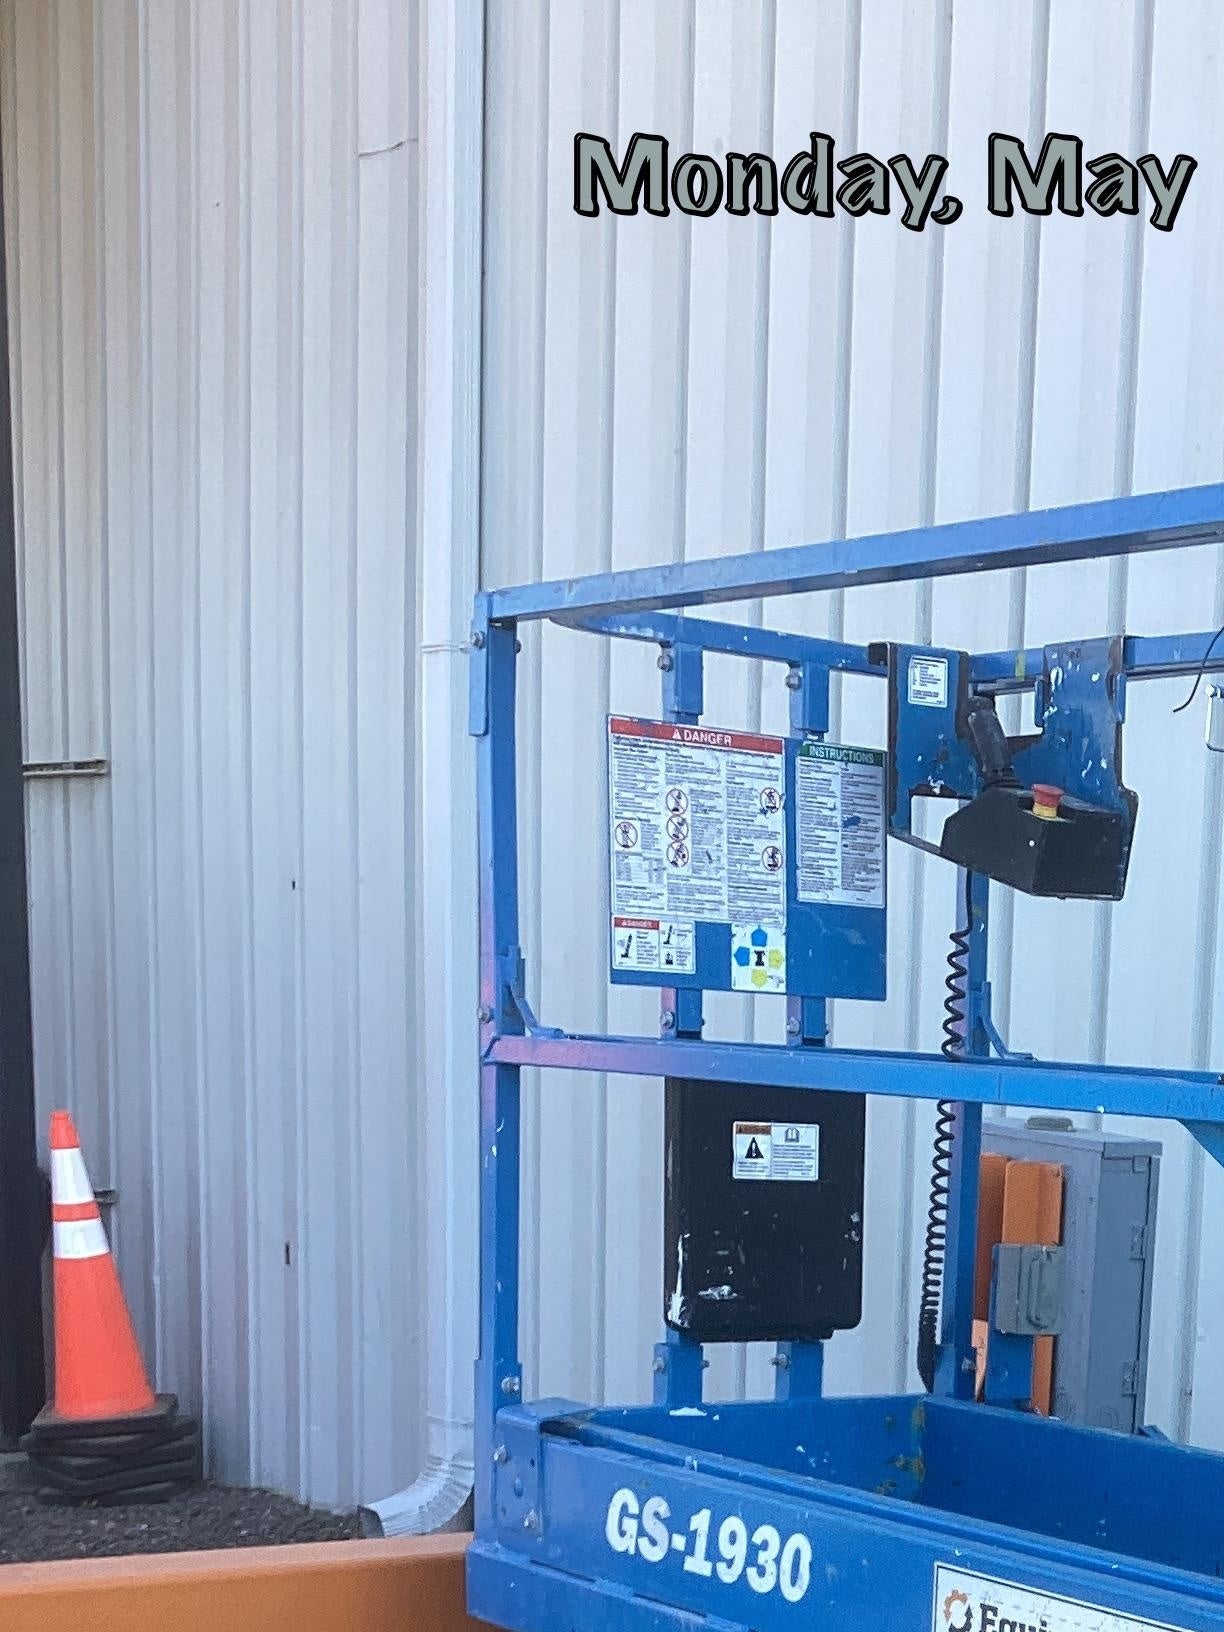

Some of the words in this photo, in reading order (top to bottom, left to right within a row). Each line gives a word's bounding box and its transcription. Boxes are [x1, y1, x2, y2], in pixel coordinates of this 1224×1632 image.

[684, 729, 732, 746] DANGER
[809, 744, 875, 764] INSTRUCTIONS
[606, 1488, 812, 1603] GS-1930
